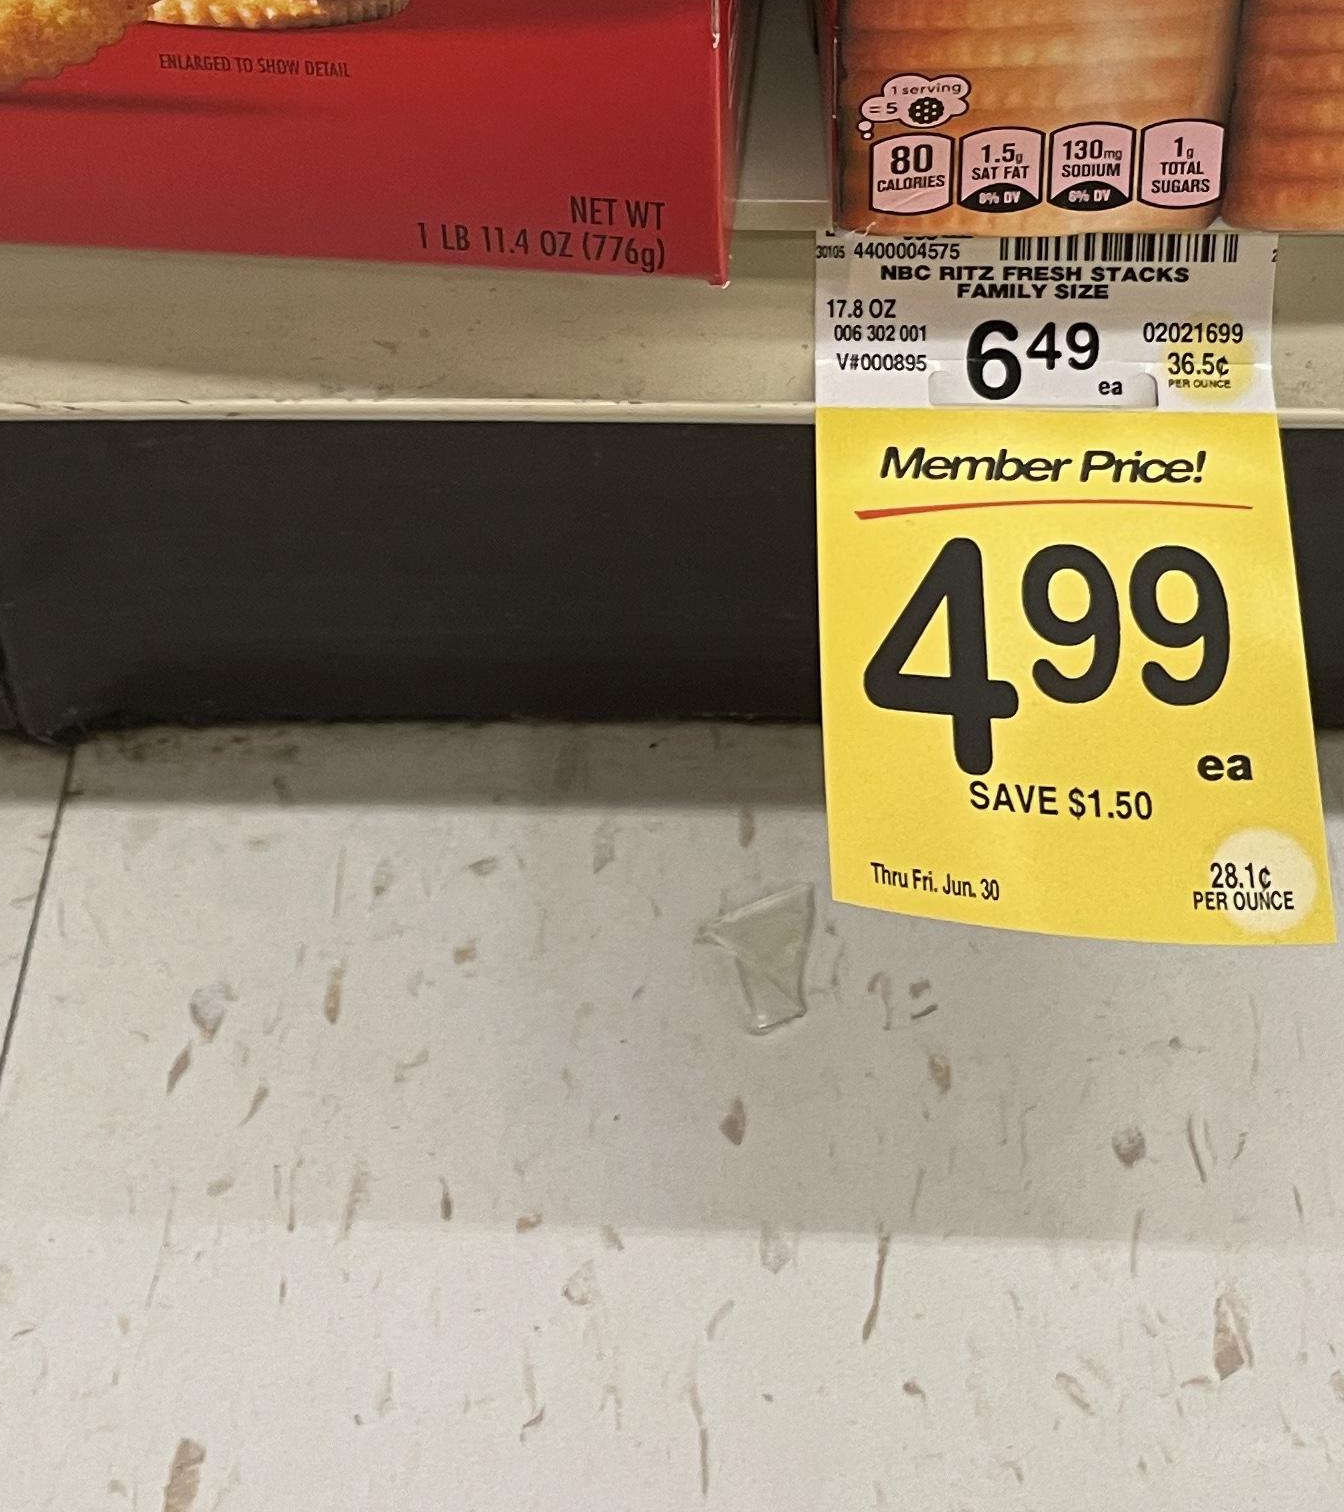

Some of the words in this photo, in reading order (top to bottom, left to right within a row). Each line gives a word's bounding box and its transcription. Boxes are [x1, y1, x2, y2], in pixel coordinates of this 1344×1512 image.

[159, 53, 233, 74] ENLARGED
[257, 57, 301, 76] SHOW
[304, 59, 351, 78] DETAIL
[901, 82, 963, 97] serving
[980, 143, 1024, 166] 1.5g
[1062, 139, 1123, 163] 130mg
[1174, 136, 1195, 160] 1g
[890, 143, 934, 174] 80
[1159, 160, 1205, 177] TOTAL
[972, 166, 1000, 181] SAT
[1003, 165, 1030, 181] FAT
[1061, 162, 1122, 178] SODIUM
[877, 174, 946, 194] CALORIES
[1151, 177, 1211, 194] SUGARS
[569, 195, 619, 229] NET
[624, 199, 666, 231] WT
[440, 224, 472, 253] LB
[481, 224, 530, 256] 11.4
[539, 229, 576, 261] OZ
[581, 231, 667, 274] (776g)
[854, 242, 961, 260] 4400004575
[880, 264, 931, 282] NBC
[938, 264, 995, 282] RITZ
[1002, 265, 1085, 283] FRESH
[1089, 266, 1190, 284] STACKS
[957, 284, 1048, 300] FAMILY
[1054, 284, 1110, 300] SIZE
[826, 299, 864, 319] 17.8
[868, 299, 897, 319] OZ
[833, 325, 862, 342] 006
[866, 325, 897, 342] 302
[899, 325, 927, 342] 001
[1143, 323, 1244, 345] 02021699
[836, 353, 928, 372] V#000895
[1098, 380, 1123, 396] ea
[1168, 379, 1191, 389] PER
[1193, 379, 1231, 389] OUNCE
[879, 446, 1072, 483] Member
[1080, 450, 1207, 485] Price!
[1197, 752, 1255, 782] ea
[969, 780, 1059, 816] SAVE
[1067, 787, 1153, 821] $1.50
[870, 861, 910, 888] Thru
[912, 868, 939, 894] Fri.
[942, 874, 977, 900] Jun.
[979, 877, 1001, 901] 30
[1209, 861, 1272, 891] 28.1¢
[1193, 890, 1229, 911] PER
[1232, 890, 1295, 911] OUNCE
